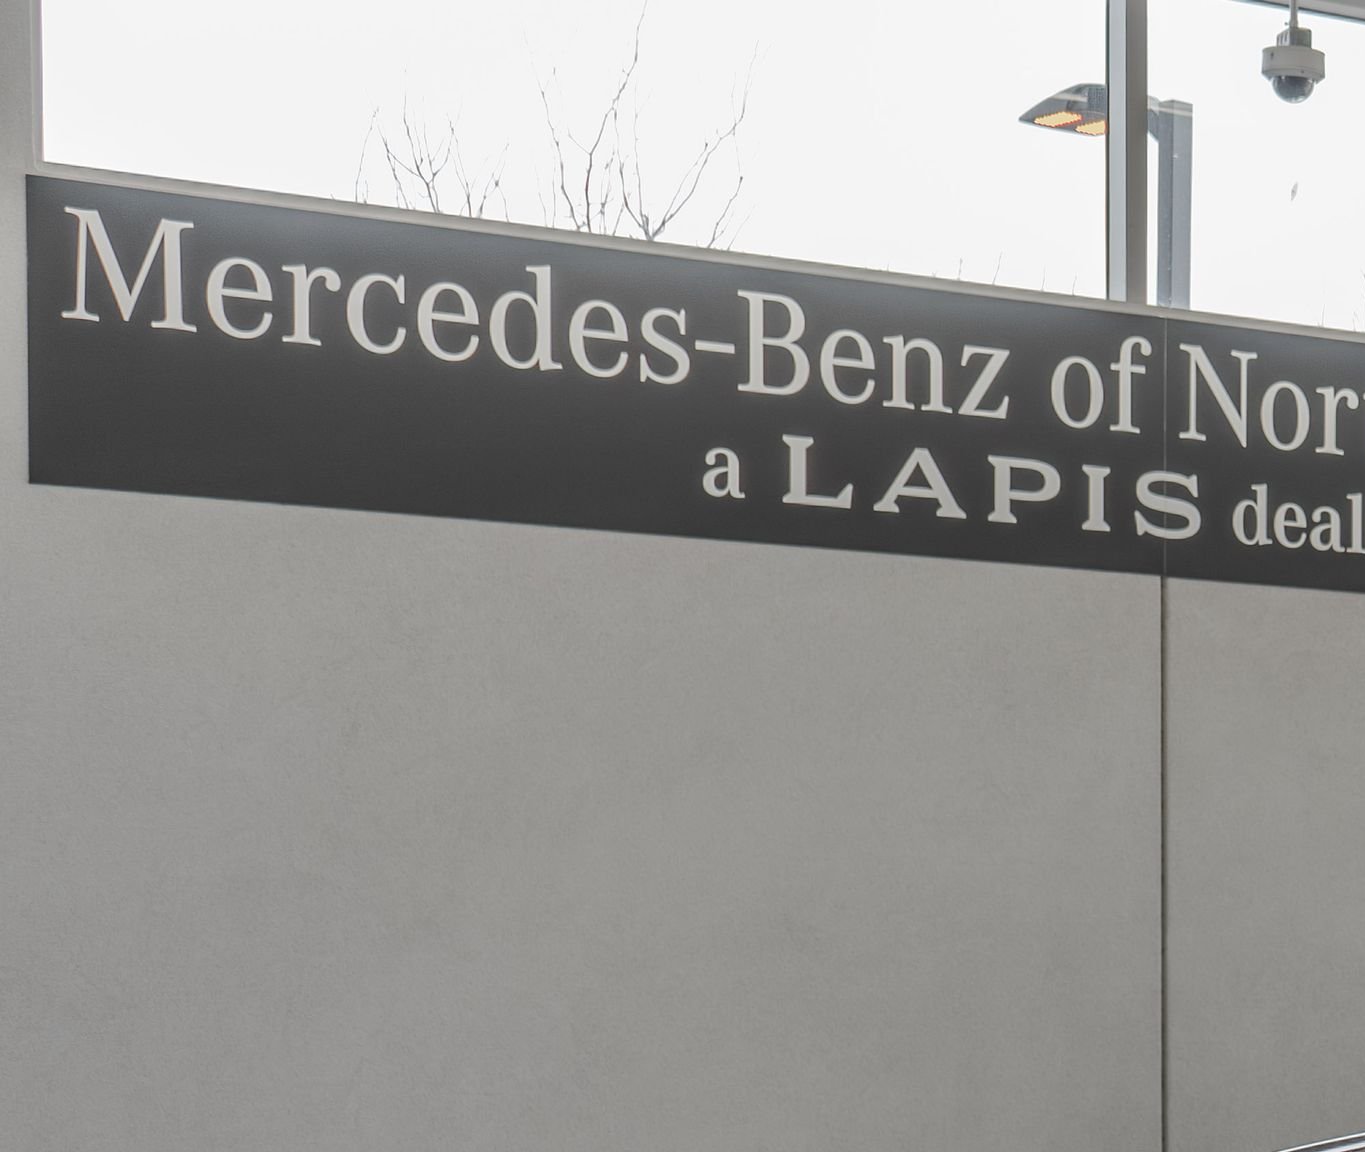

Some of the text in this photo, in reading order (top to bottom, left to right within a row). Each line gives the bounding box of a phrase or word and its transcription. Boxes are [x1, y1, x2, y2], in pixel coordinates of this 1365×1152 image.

[61, 205, 1010, 419] Mercedes-Benz
[1050, 335, 1152, 435] of
[702, 447, 746, 499] a
[782, 434, 1201, 540] LAPIS
